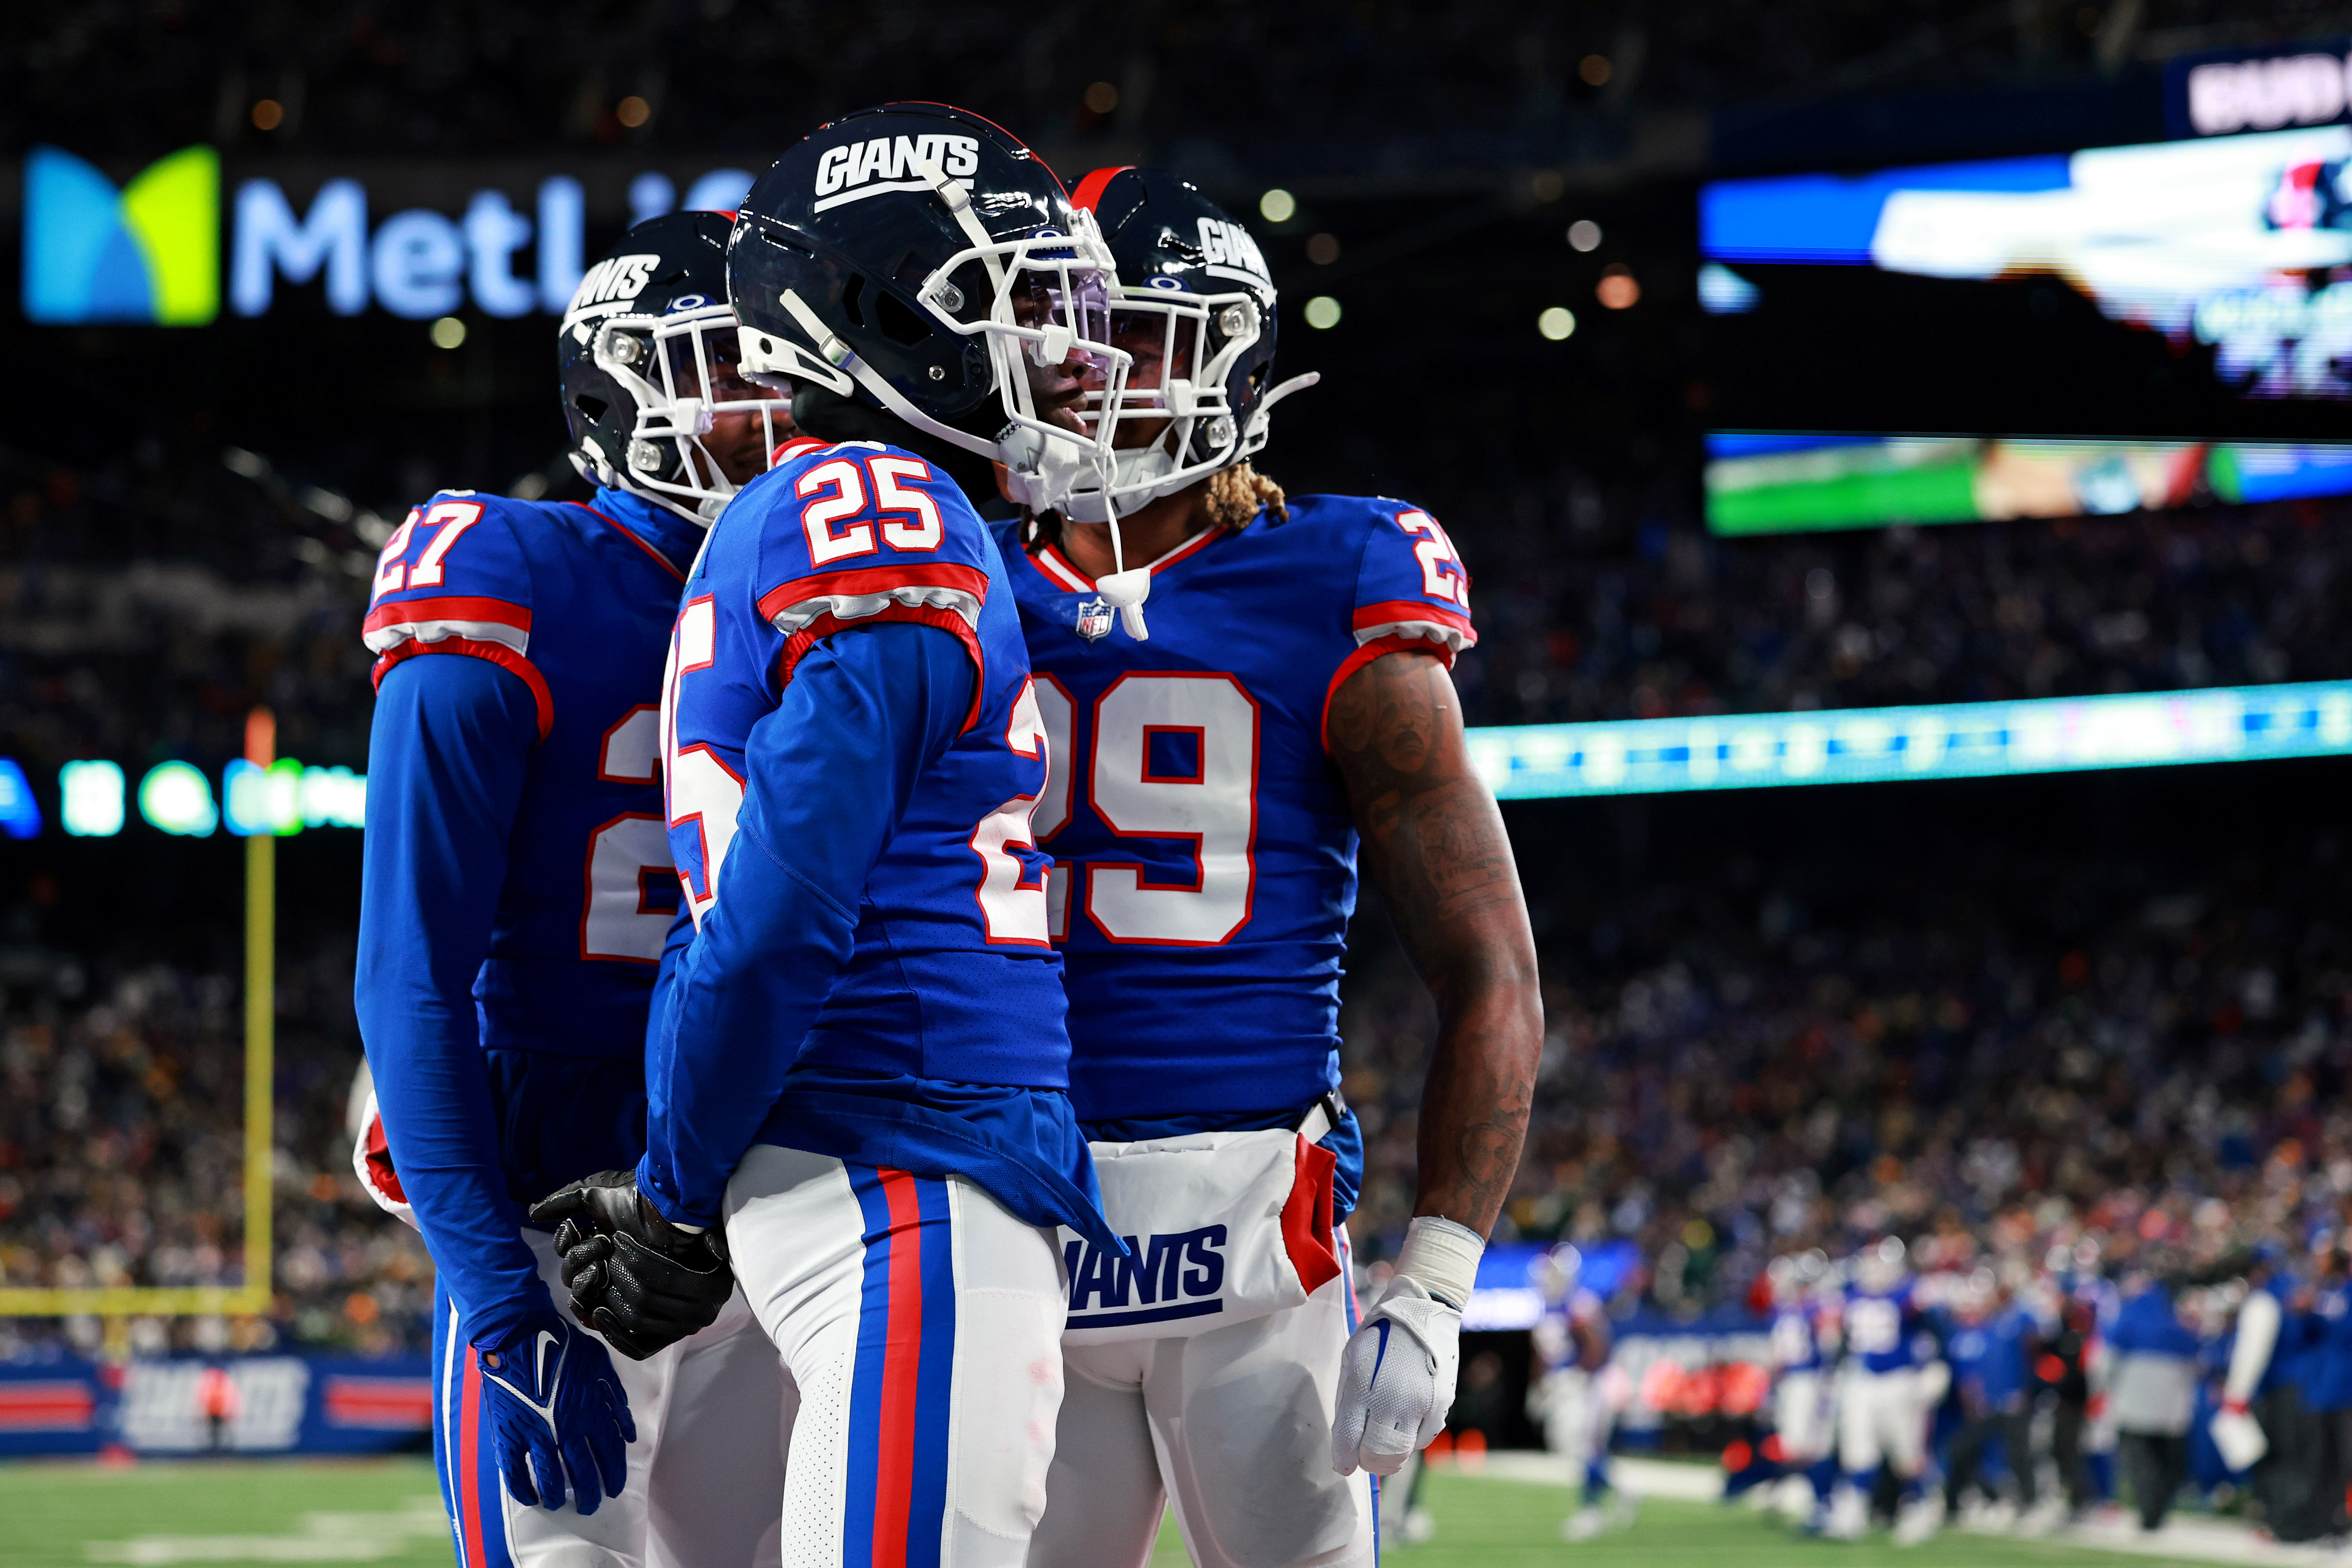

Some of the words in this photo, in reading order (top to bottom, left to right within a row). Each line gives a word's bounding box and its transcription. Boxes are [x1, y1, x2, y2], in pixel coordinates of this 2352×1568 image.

[815, 134, 979, 197] GIANTS
[233, 168, 754, 317] MetL
[568, 254, 661, 314] ANTS
[373, 500, 486, 607] 27
[794, 454, 945, 570] 25
[1395, 509, 1469, 610] 2
[1082, 617, 1105, 634] NFL
[1068, 1224, 1227, 1311] IANTS
